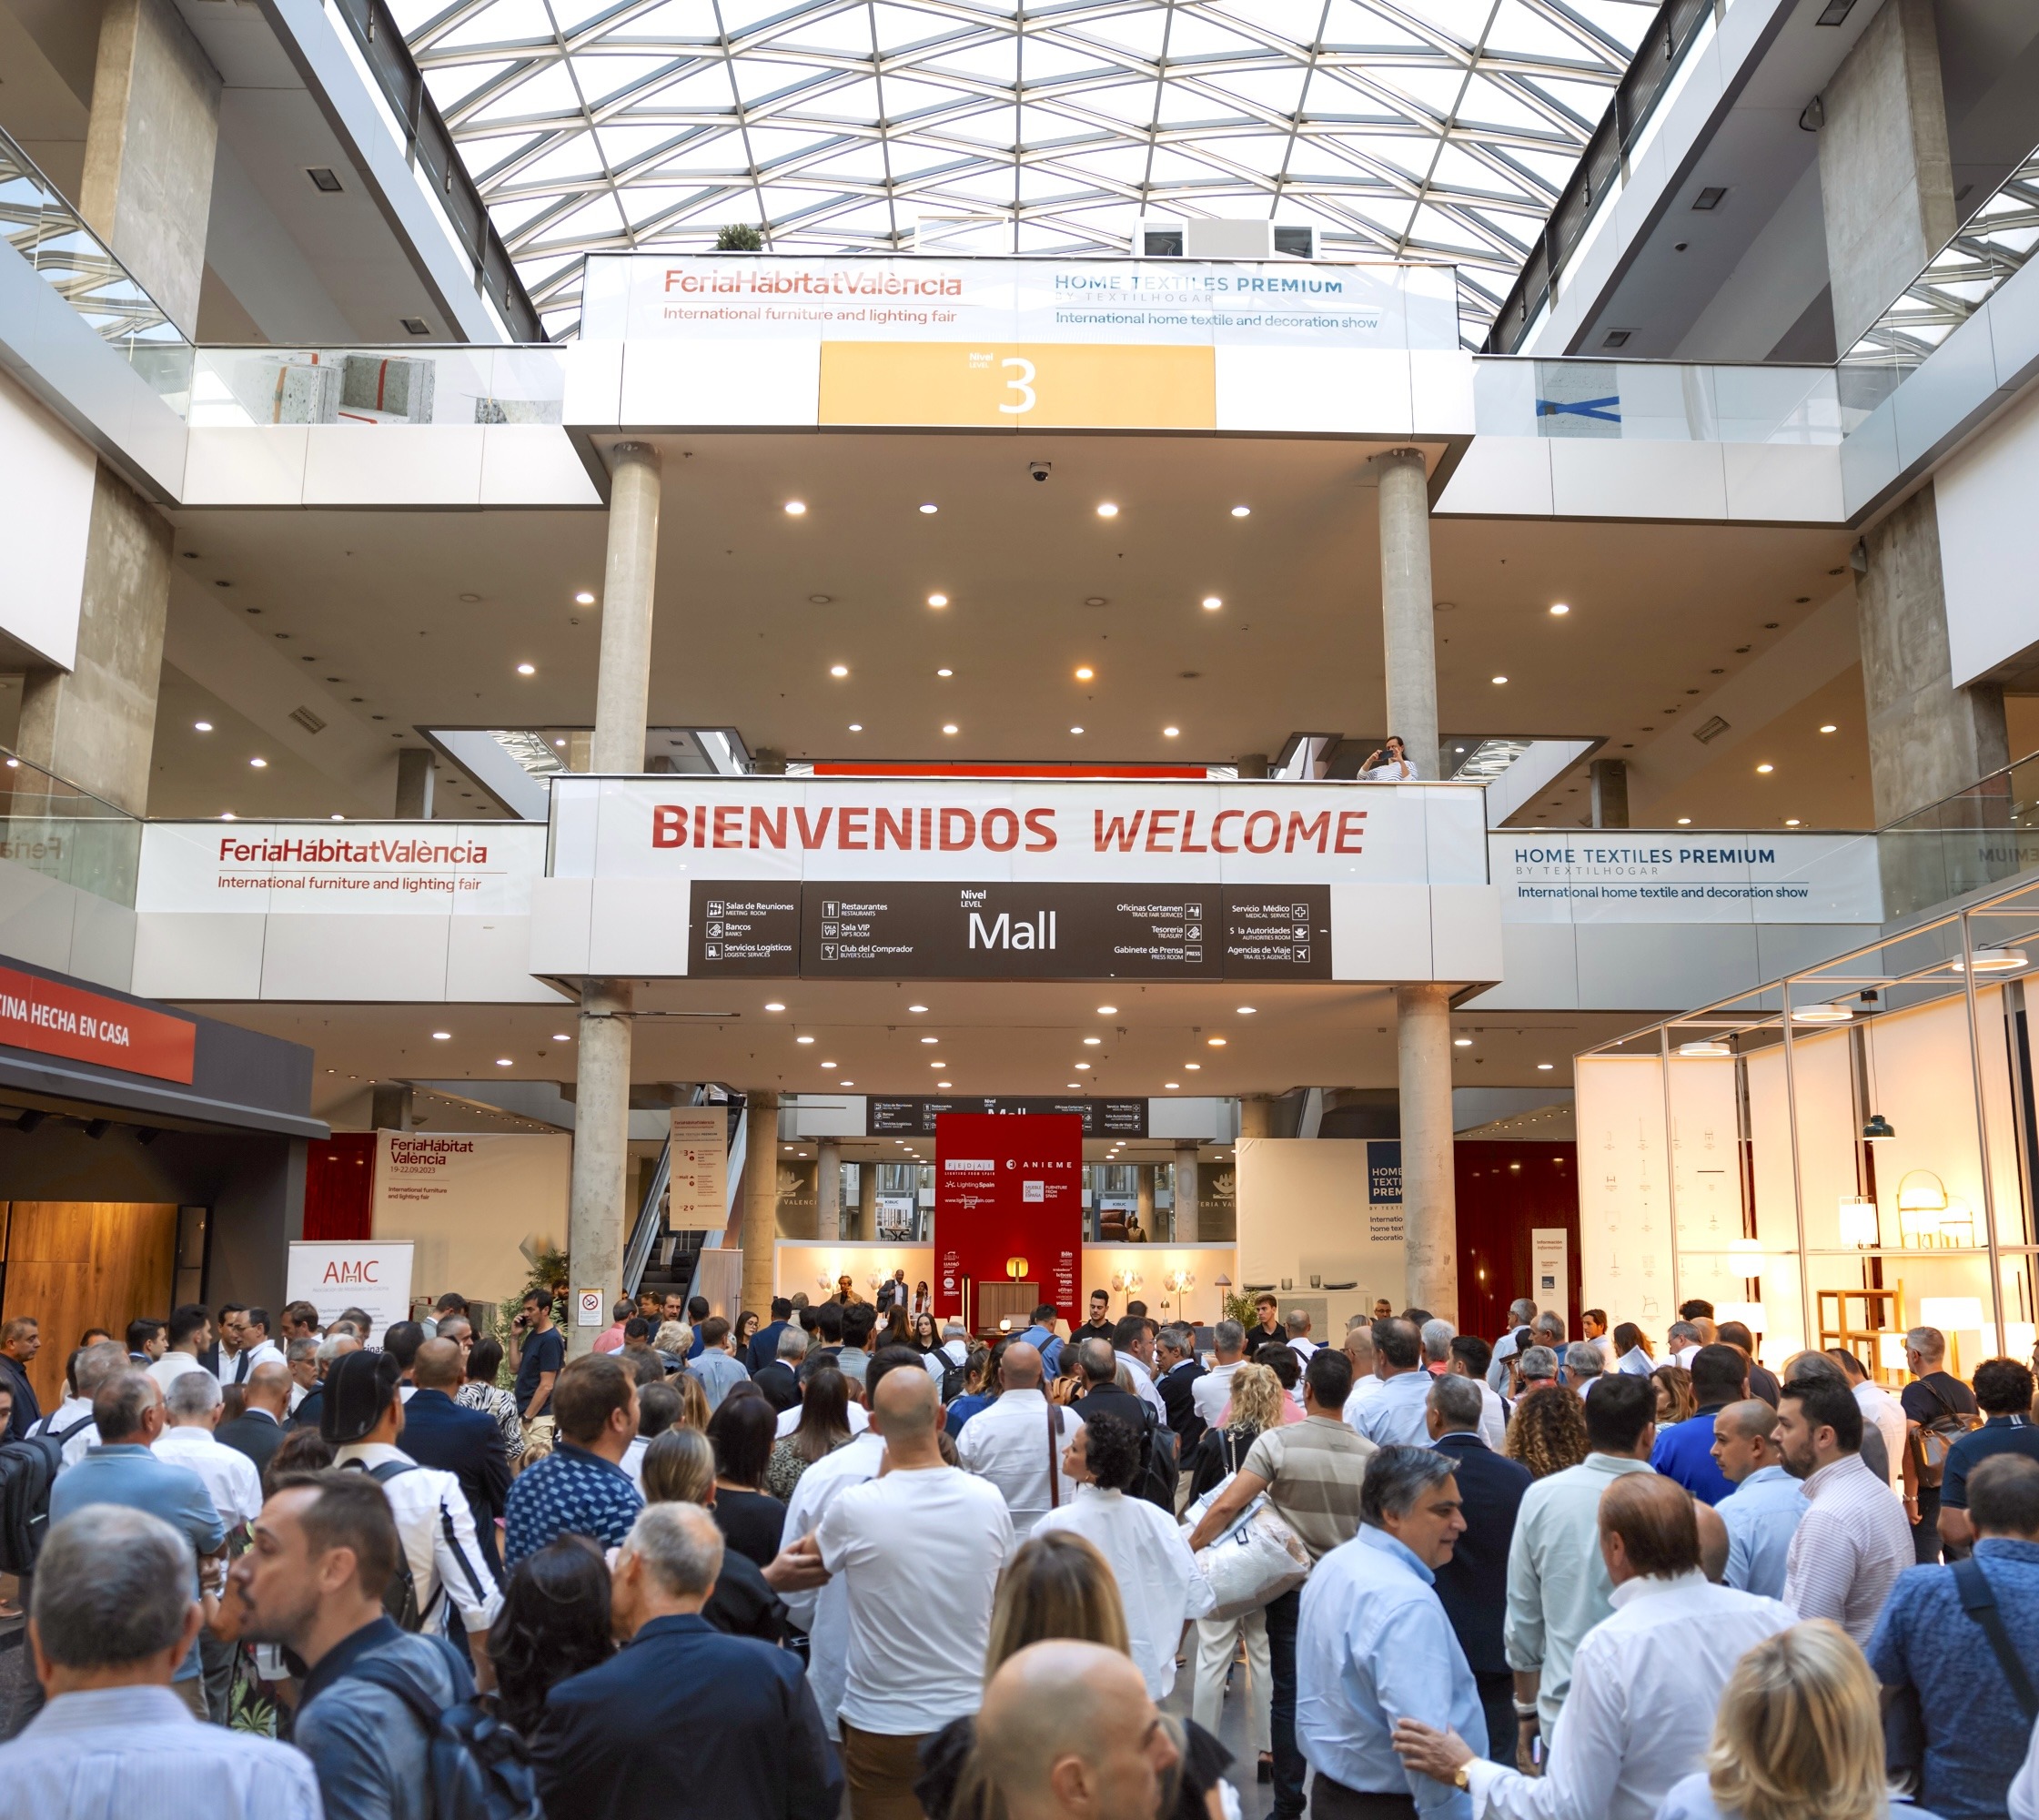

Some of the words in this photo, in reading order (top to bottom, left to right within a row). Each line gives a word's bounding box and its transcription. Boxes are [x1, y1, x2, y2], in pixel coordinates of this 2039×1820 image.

[665, 269, 962, 296] FeriaHábitatValència
[1055, 275, 1121, 289] HOME
[1131, 277, 1229, 291] TEXTILES
[1237, 278, 1343, 293] PREMIUM
[1086, 292, 1213, 303] TEXTILHOGAR
[664, 308, 761, 320] International
[765, 308, 833, 320] furniture
[836, 309, 865, 321] and
[870, 309, 927, 325] lighting
[932, 309, 957, 322] fair
[1056, 312, 1145, 324] International
[1148, 313, 1188, 325] home
[1191, 315, 1234, 326] textile
[1237, 315, 1262, 327] and
[1265, 315, 1339, 329] decoration
[1341, 317, 1378, 329] show
[969, 352, 994, 361] Nivel
[999, 358, 1036, 414] 3
[651, 804, 1058, 853] BIENVENIDOS
[1094, 809, 1368, 854] WELCOME
[219, 838, 487, 864] FeriaHábitatValència
[1515, 849, 1575, 864] HOME
[1583, 849, 1672, 864] TEXTILES
[1680, 849, 1775, 864] PREMIUM
[1516, 866, 1533, 875] BY
[1543, 866, 1659, 875] TEXTILHOGAR
[217, 876, 305, 889] International
[308, 877, 370, 890] furniture
[373, 878, 399, 890] and
[402, 877, 455, 894] lighting
[459, 878, 482, 891] fair
[961, 889, 986, 900] Nivel
[1518, 886, 1599, 898] International
[1601, 886, 1637, 898] home
[1640, 887, 1679, 898] textile
[1681, 887, 1704, 899] and
[1707, 887, 1774, 899] decoration
[1776, 887, 1809, 899] show
[726, 902, 744, 910] Salas
[745, 902, 755, 910] de
[756, 903, 794, 911] Reuniones
[841, 903, 888, 911] Restaurantes
[961, 900, 983, 908] LEVEL
[1116, 904, 1146, 912] Oficinas
[1231, 905, 1260, 913] Servicio
[1263, 905, 1290, 913] Médico
[725, 923, 752, 931] Bancos
[969, 911, 1055, 950] Mall
[756, 944, 792, 953] Logísticos
[858, 945, 870, 953] del
[871, 945, 914, 954] Comprador
[1227, 946, 1261, 956] Agencias
[1273, 946, 1291, 956] Viaje
[0, 994, 28, 1022] INA
[31, 1002, 76, 1034] HECHA
[80, 1015, 97, 1038] EN
[99, 1021, 130, 1046] CASA
[390, 1138, 473, 1153] FeriaHábitat
[391, 1152, 447, 1165] València
[390, 1166, 436, 1174] 19-22.09.2023
[323, 1260, 379, 1284] AMC
